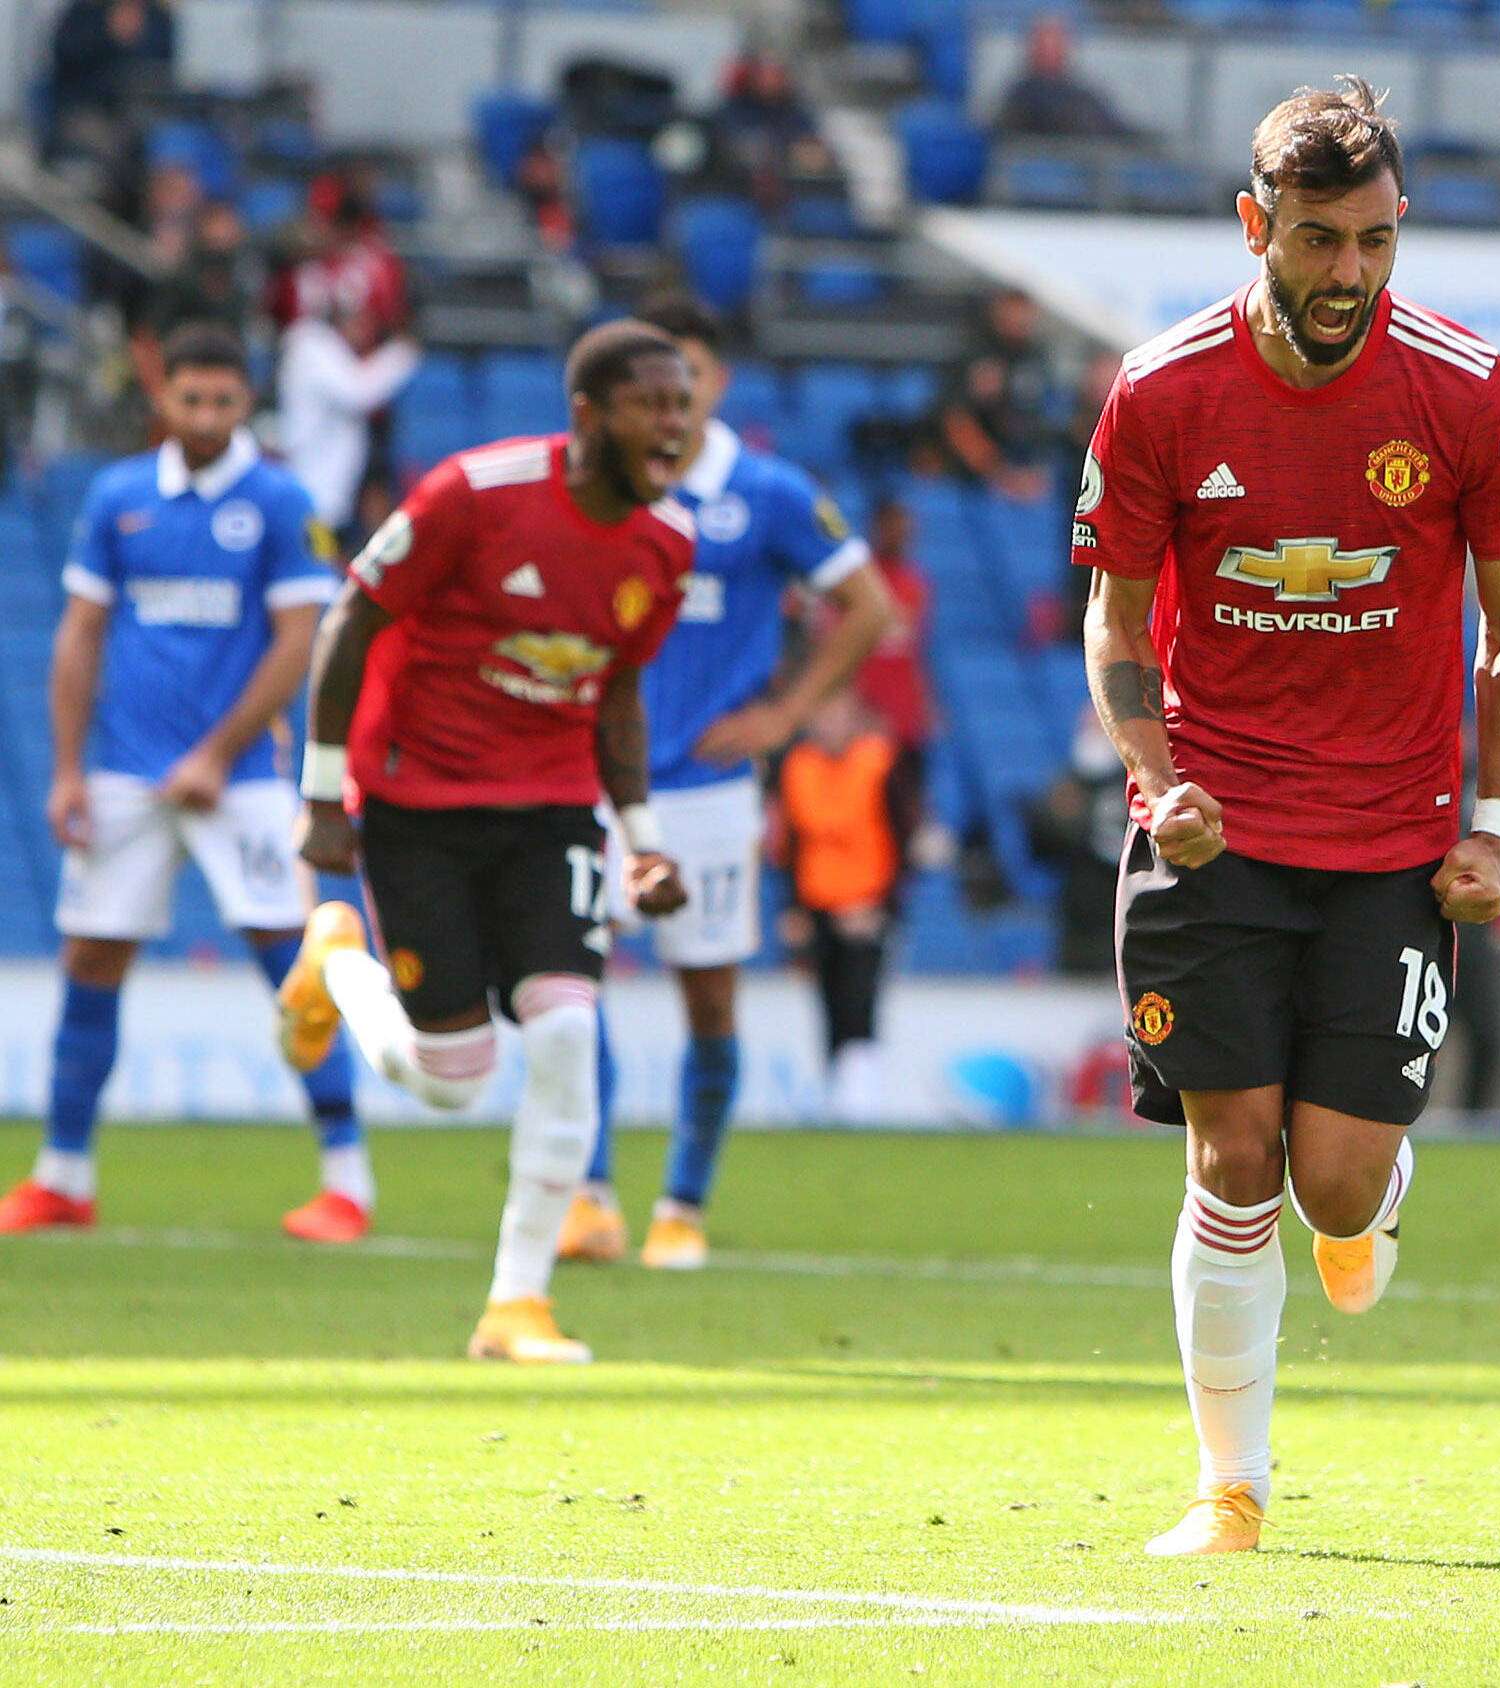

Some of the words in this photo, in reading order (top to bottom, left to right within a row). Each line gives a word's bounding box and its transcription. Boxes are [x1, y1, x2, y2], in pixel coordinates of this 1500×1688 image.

[1197, 486, 1245, 499] adidas
[1380, 490, 1415, 502] UNITED
[1214, 603, 1399, 633] CHEVROLET
[1396, 947, 1449, 1050] 18
